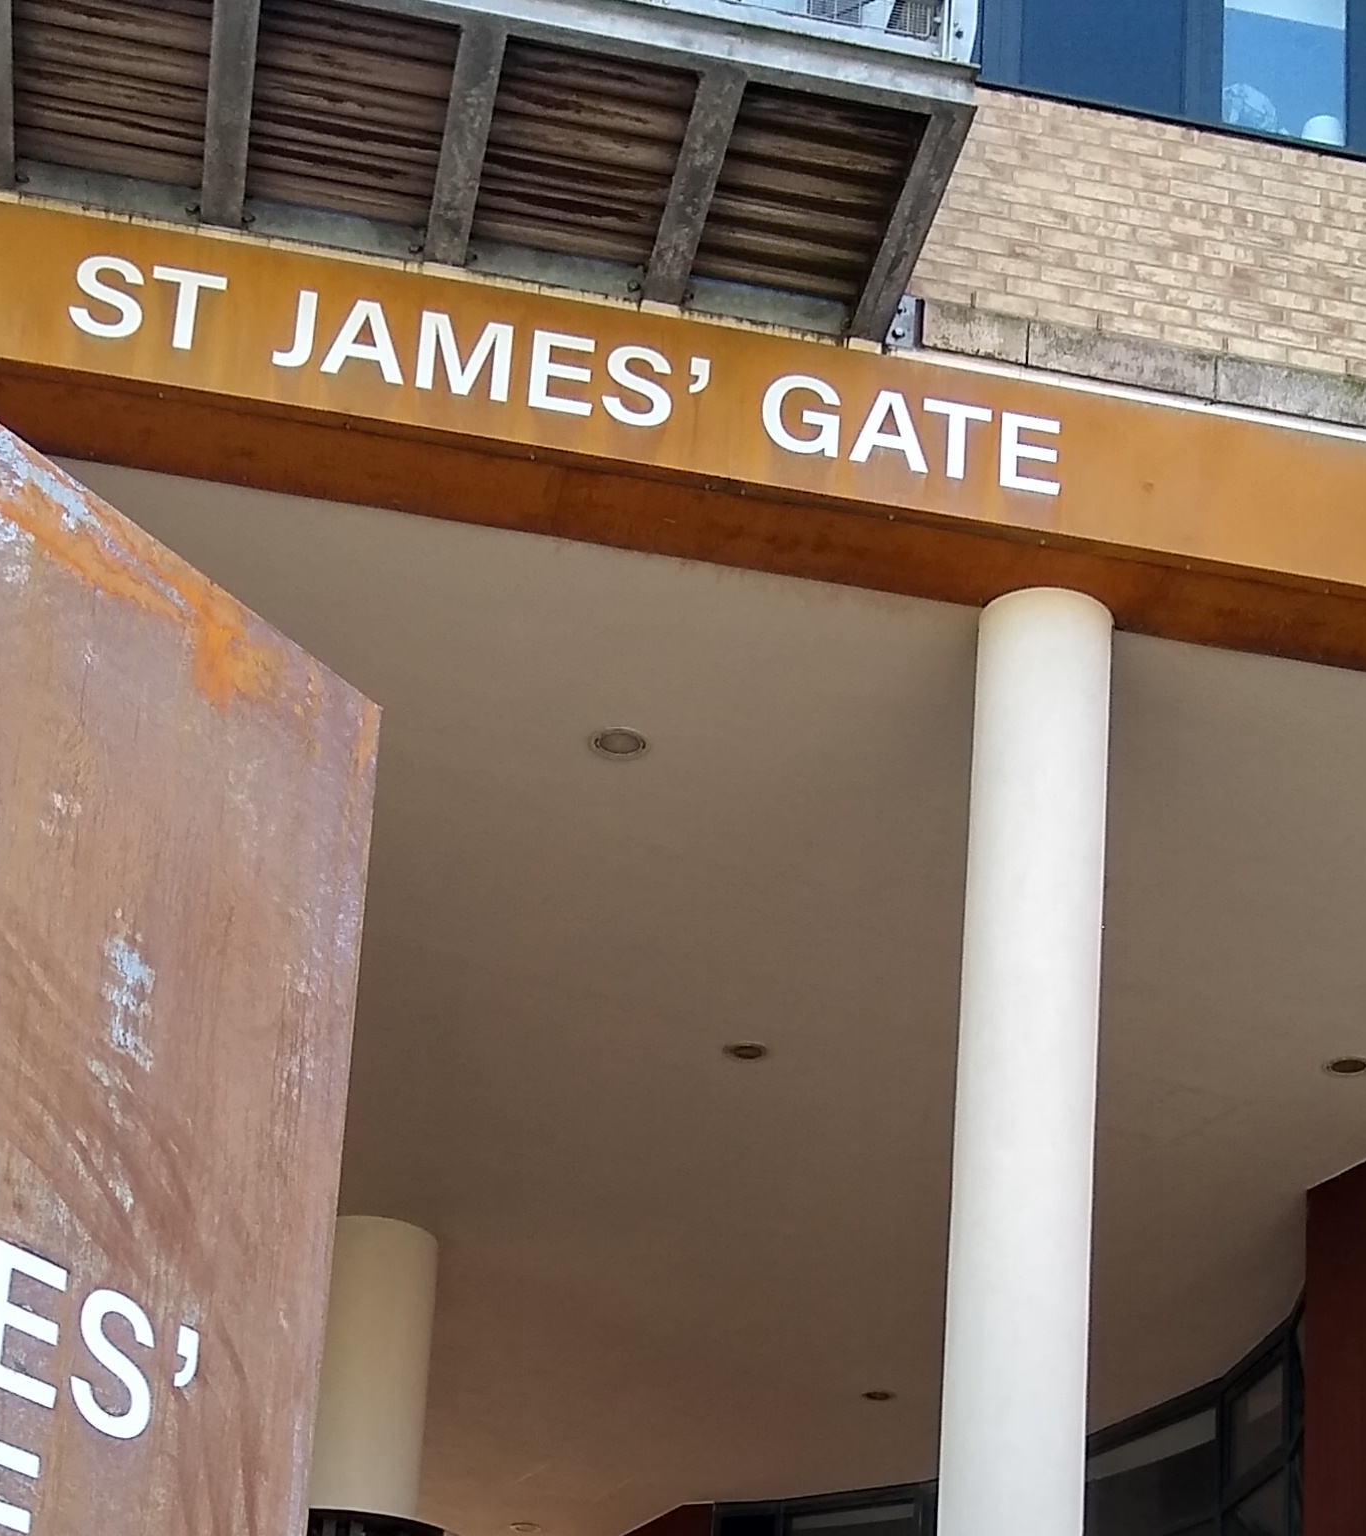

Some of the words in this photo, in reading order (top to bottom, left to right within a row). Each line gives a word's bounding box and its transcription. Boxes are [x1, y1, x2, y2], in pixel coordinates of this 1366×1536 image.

[69, 255, 228, 350] ST
[272, 290, 711, 427] JAMES’
[763, 374, 1061, 496] GATE
